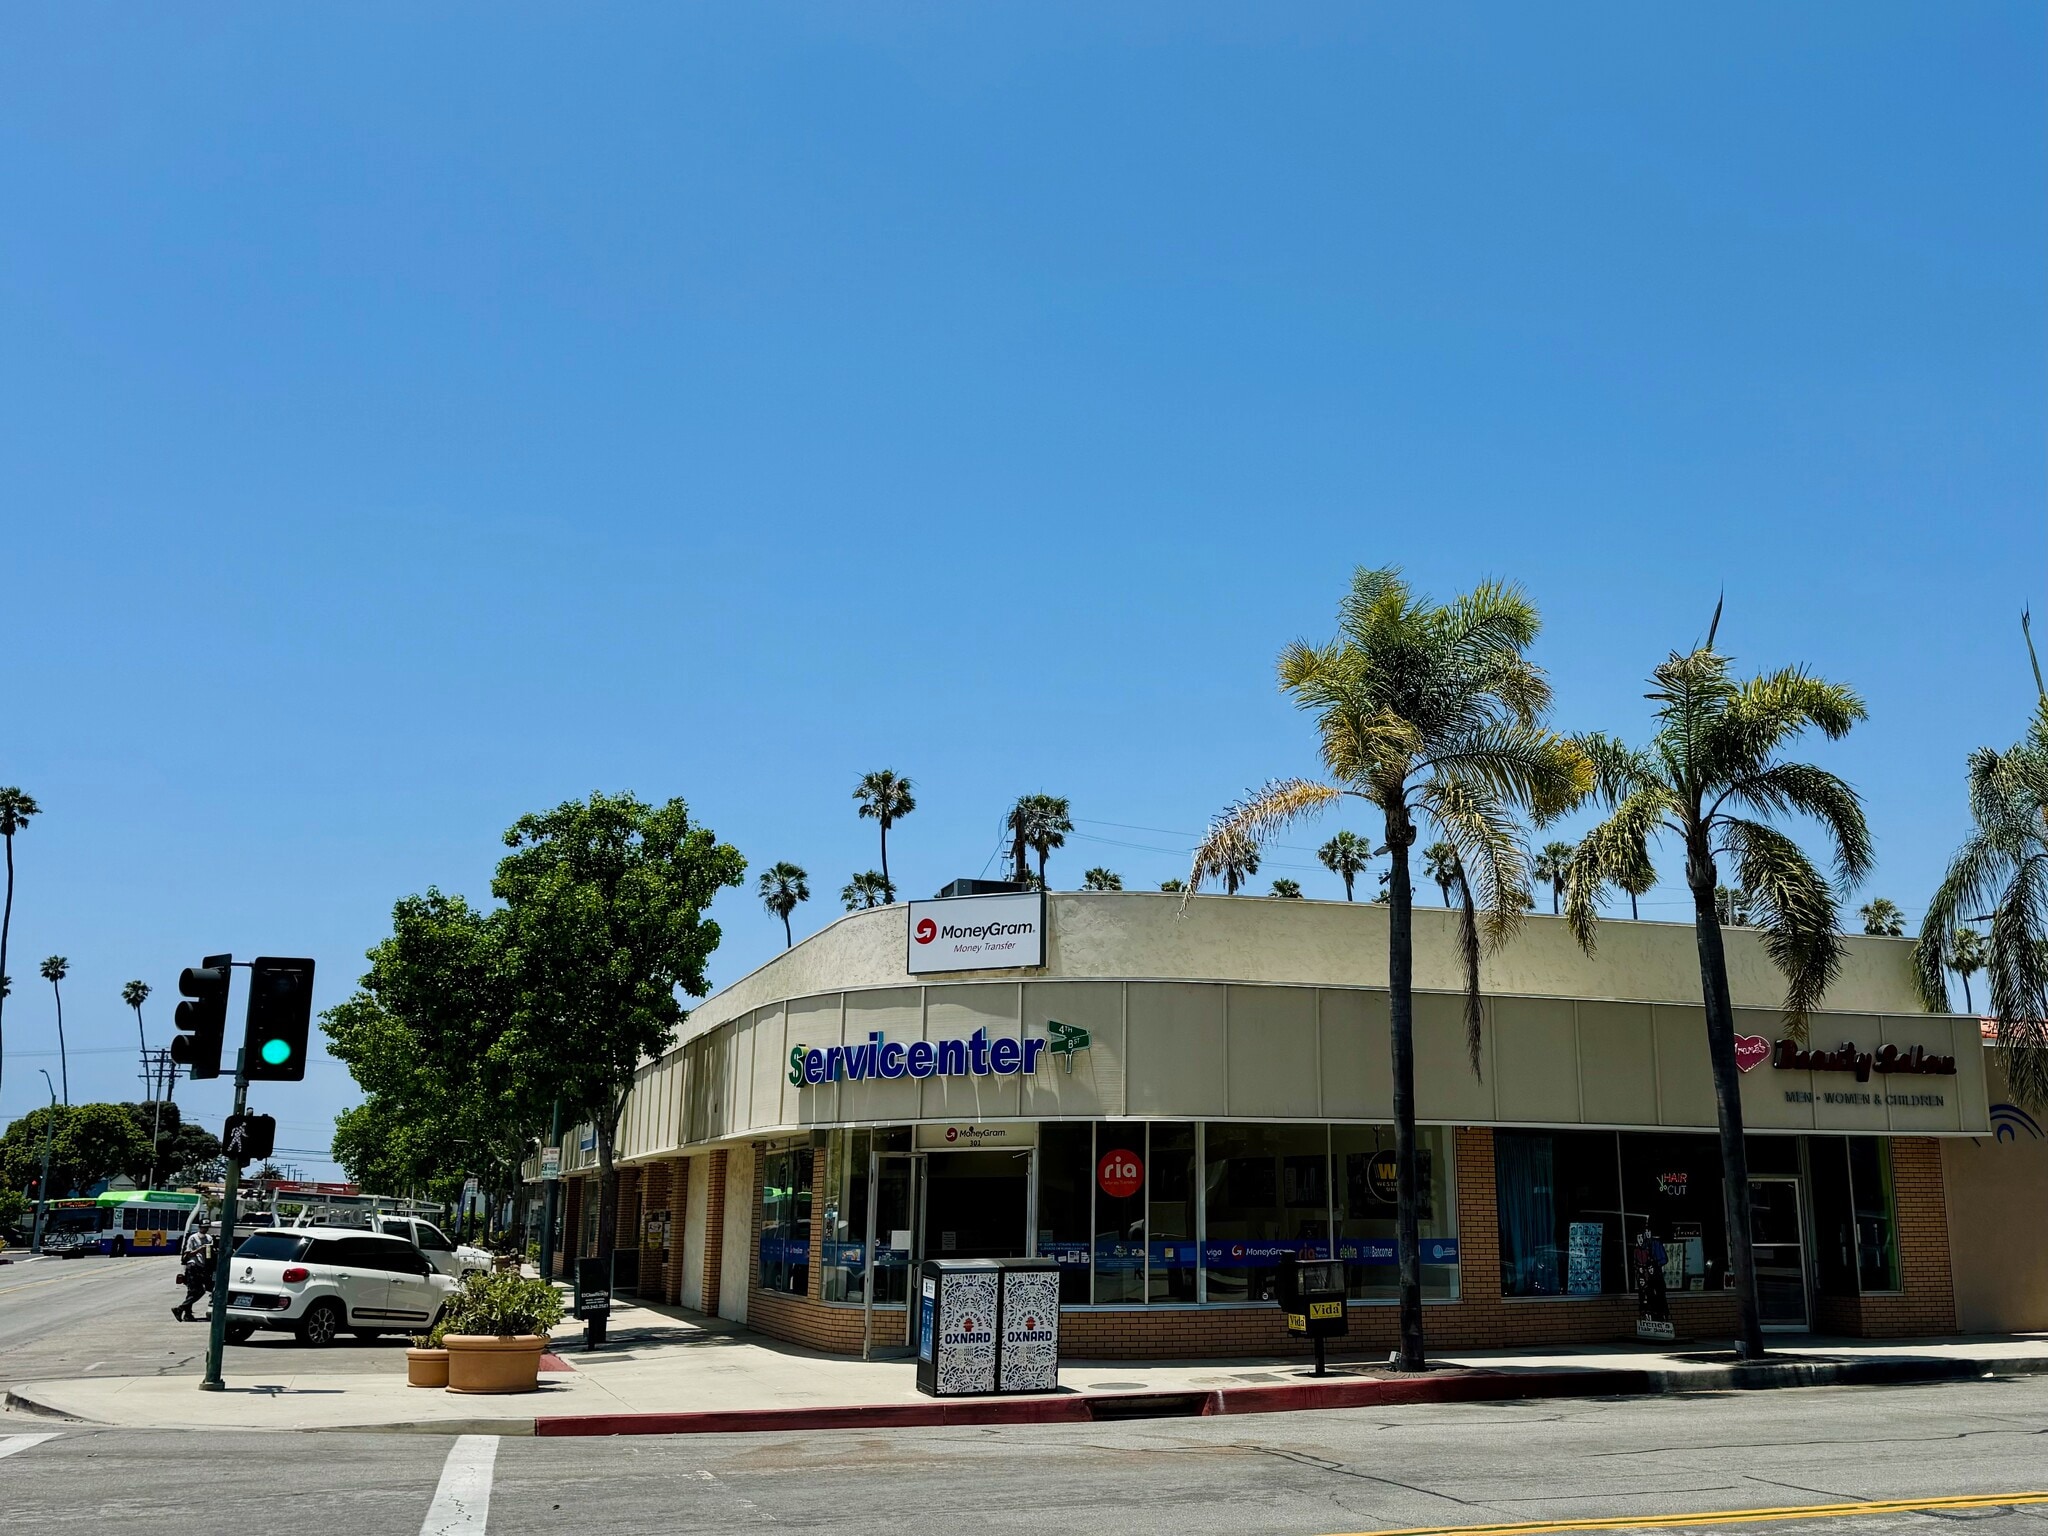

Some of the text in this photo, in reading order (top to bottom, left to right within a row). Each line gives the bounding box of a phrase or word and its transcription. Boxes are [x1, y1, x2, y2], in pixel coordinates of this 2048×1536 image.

[941, 922, 1033, 940] MoneyGram
[954, 941, 1016, 954] Money Transfer
[1785, 1091, 1944, 1107] MEN WOMEN & CHILDREN
[959, 1129, 1006, 1139] MoneyGram
[1104, 1156, 1137, 1179] ria
[1664, 1173, 1688, 1183] HAIR
[1667, 1185, 1687, 1196] CUT
[1312, 1303, 1340, 1315] Vida
[954, 1310, 983, 1328] DOWNTOWN
[1016, 1309, 1045, 1327] DOWNTOWN
[1289, 1314, 1305, 1327] Vida
[945, 1332, 991, 1344] OXNARD
[1008, 1330, 1053, 1343] OXNARD
